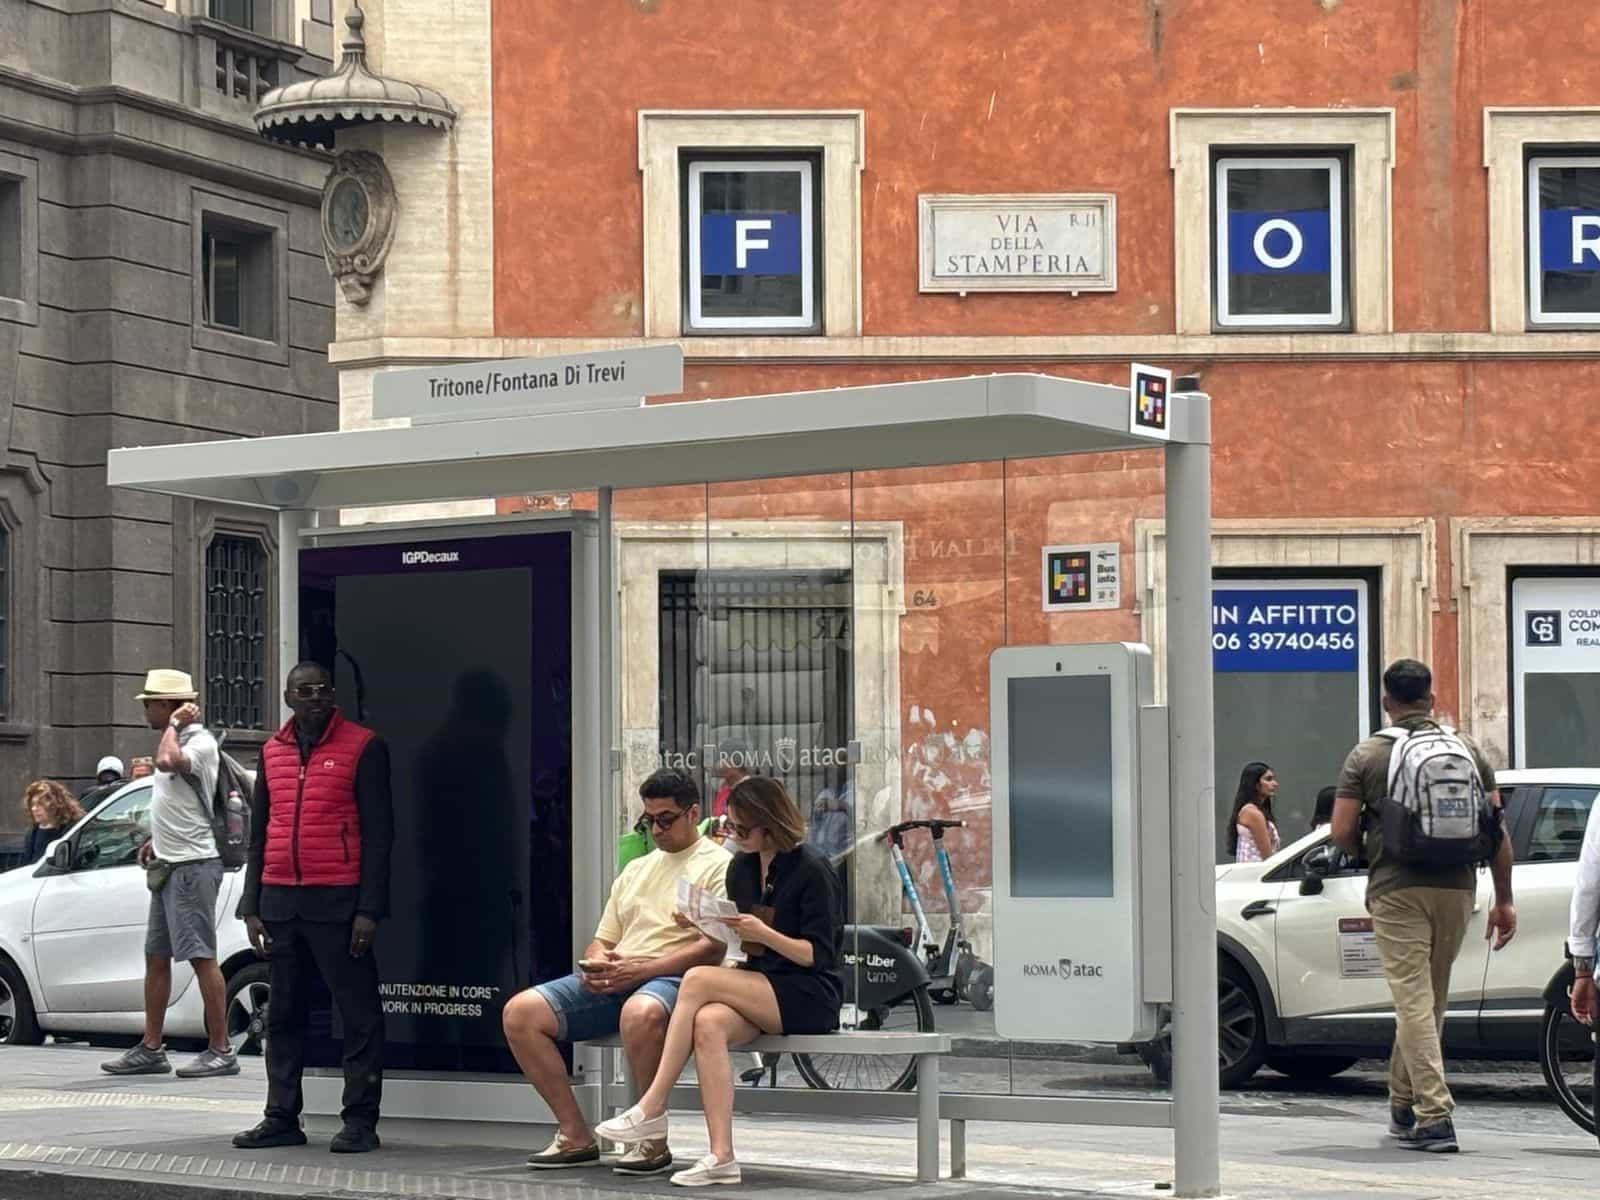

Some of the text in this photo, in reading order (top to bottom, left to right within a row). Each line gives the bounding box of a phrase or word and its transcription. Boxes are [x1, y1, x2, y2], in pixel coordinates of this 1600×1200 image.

[997, 214, 1038, 233] VIA
[736, 219, 772, 269] F
[991, 237, 1044, 250] DELLA
[1253, 218, 1303, 268] O
[1572, 215, 1600, 264] R
[947, 254, 1089, 273] STAMPERIA
[429, 360, 626, 398] Tritone/Fontana Di Trevi
[402, 551, 459, 564] IGPDecaux
[912, 590, 937, 606] 64
[1212, 605, 1356, 625] IN AFFITTO
[1568, 609, 1600, 618] COLD
[1212, 632, 1355, 650] 06 39740456
[719, 745, 847, 768] ROMA atac
[866, 953, 897, 968] Uber
[1023, 963, 1104, 977] ROMA atac
[448, 985, 460, 998] IN
[411, 1001, 422, 1014] IN
[424, 1002, 482, 1016] PROGRESS
